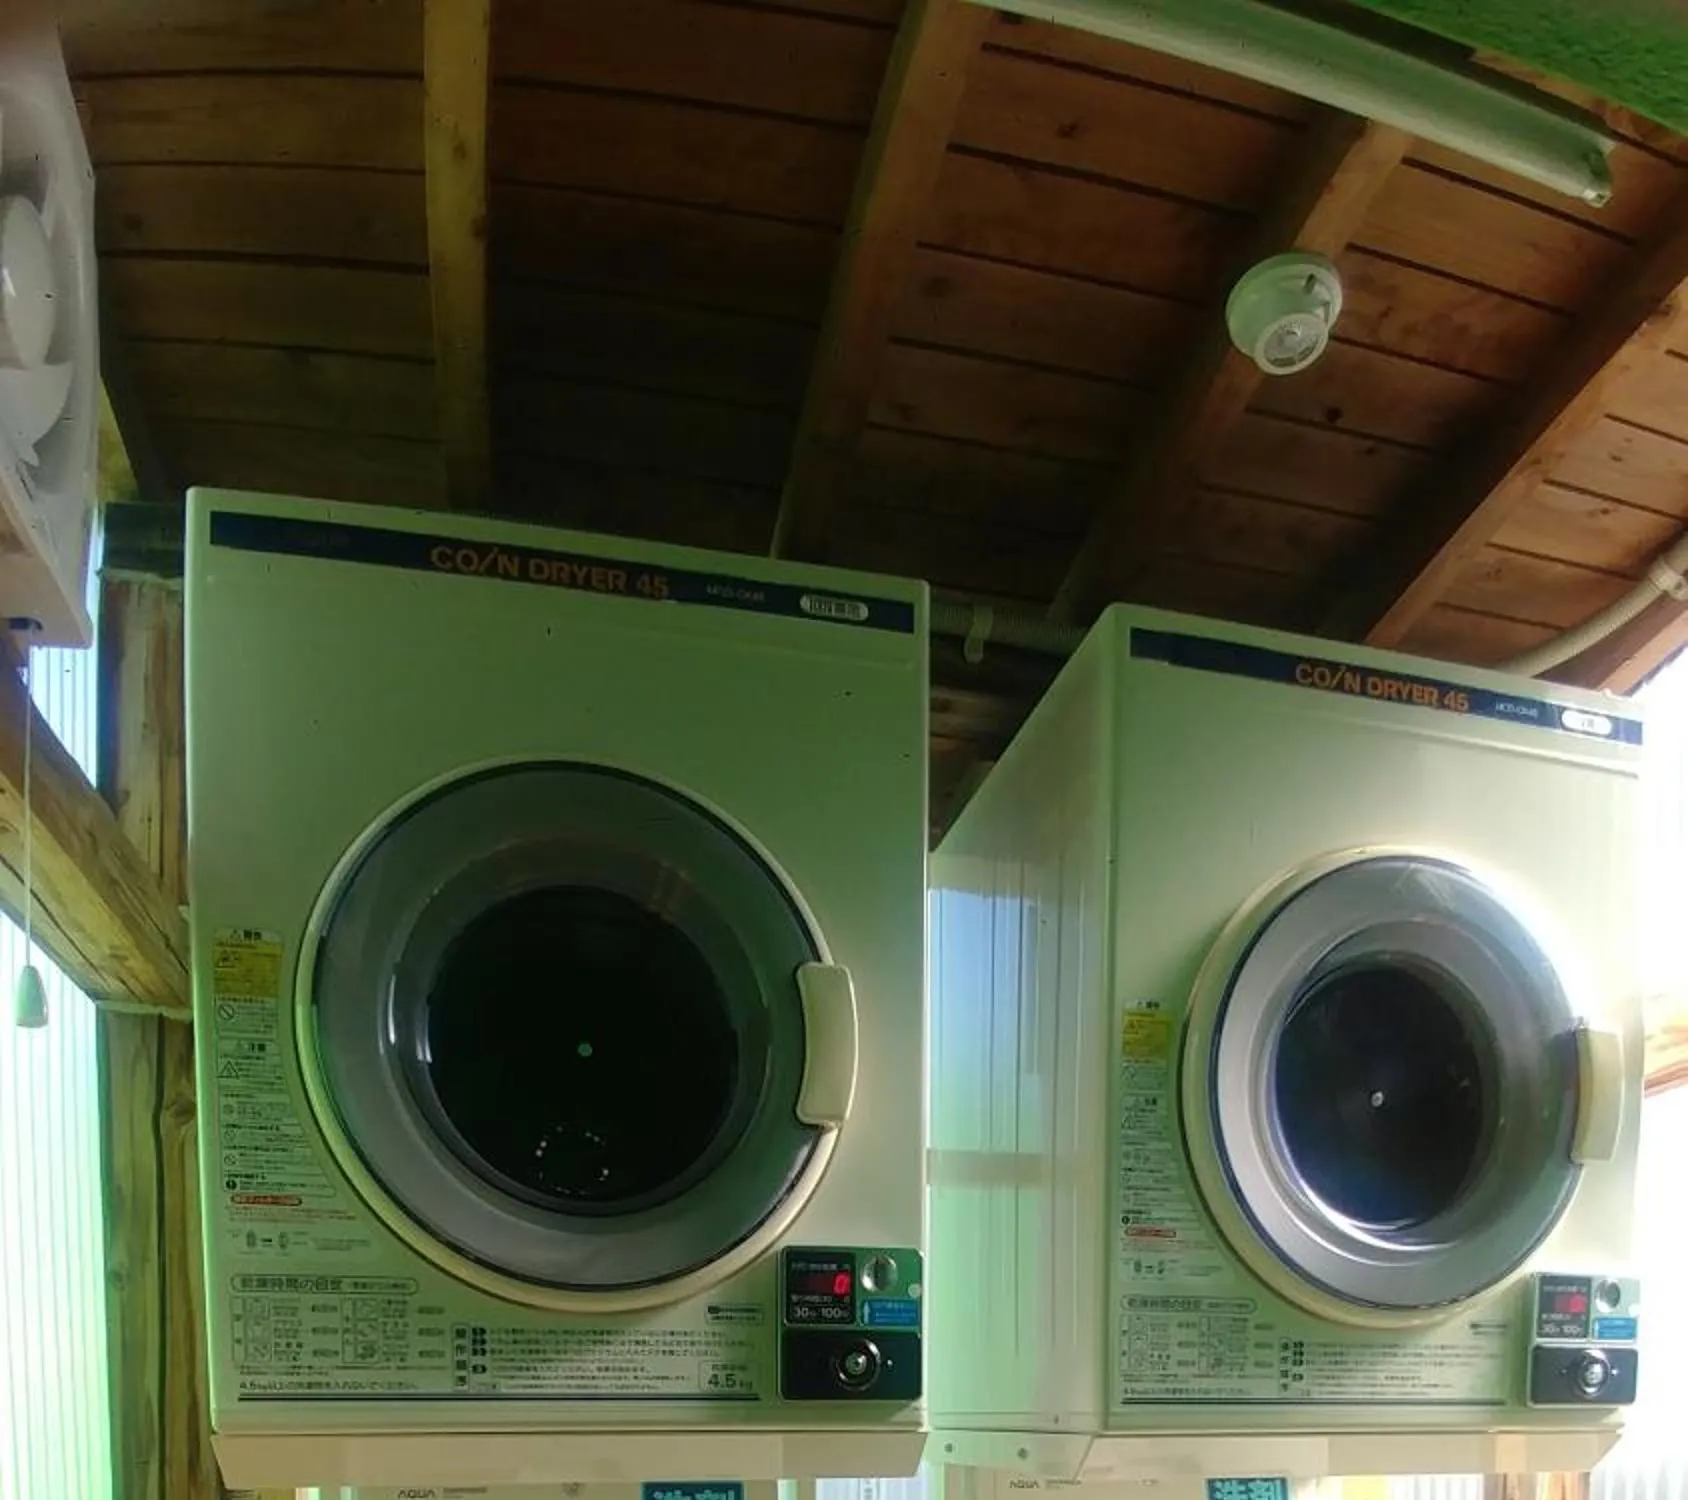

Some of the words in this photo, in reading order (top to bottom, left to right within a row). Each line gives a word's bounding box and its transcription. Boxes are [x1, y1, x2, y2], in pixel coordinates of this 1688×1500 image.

[528, 557, 627, 594] DRYER
[636, 574, 669, 600] 45
[1367, 675, 1439, 707] DRYER
[1443, 690, 1469, 712] 45
[834, 1273, 850, 1295] 0
